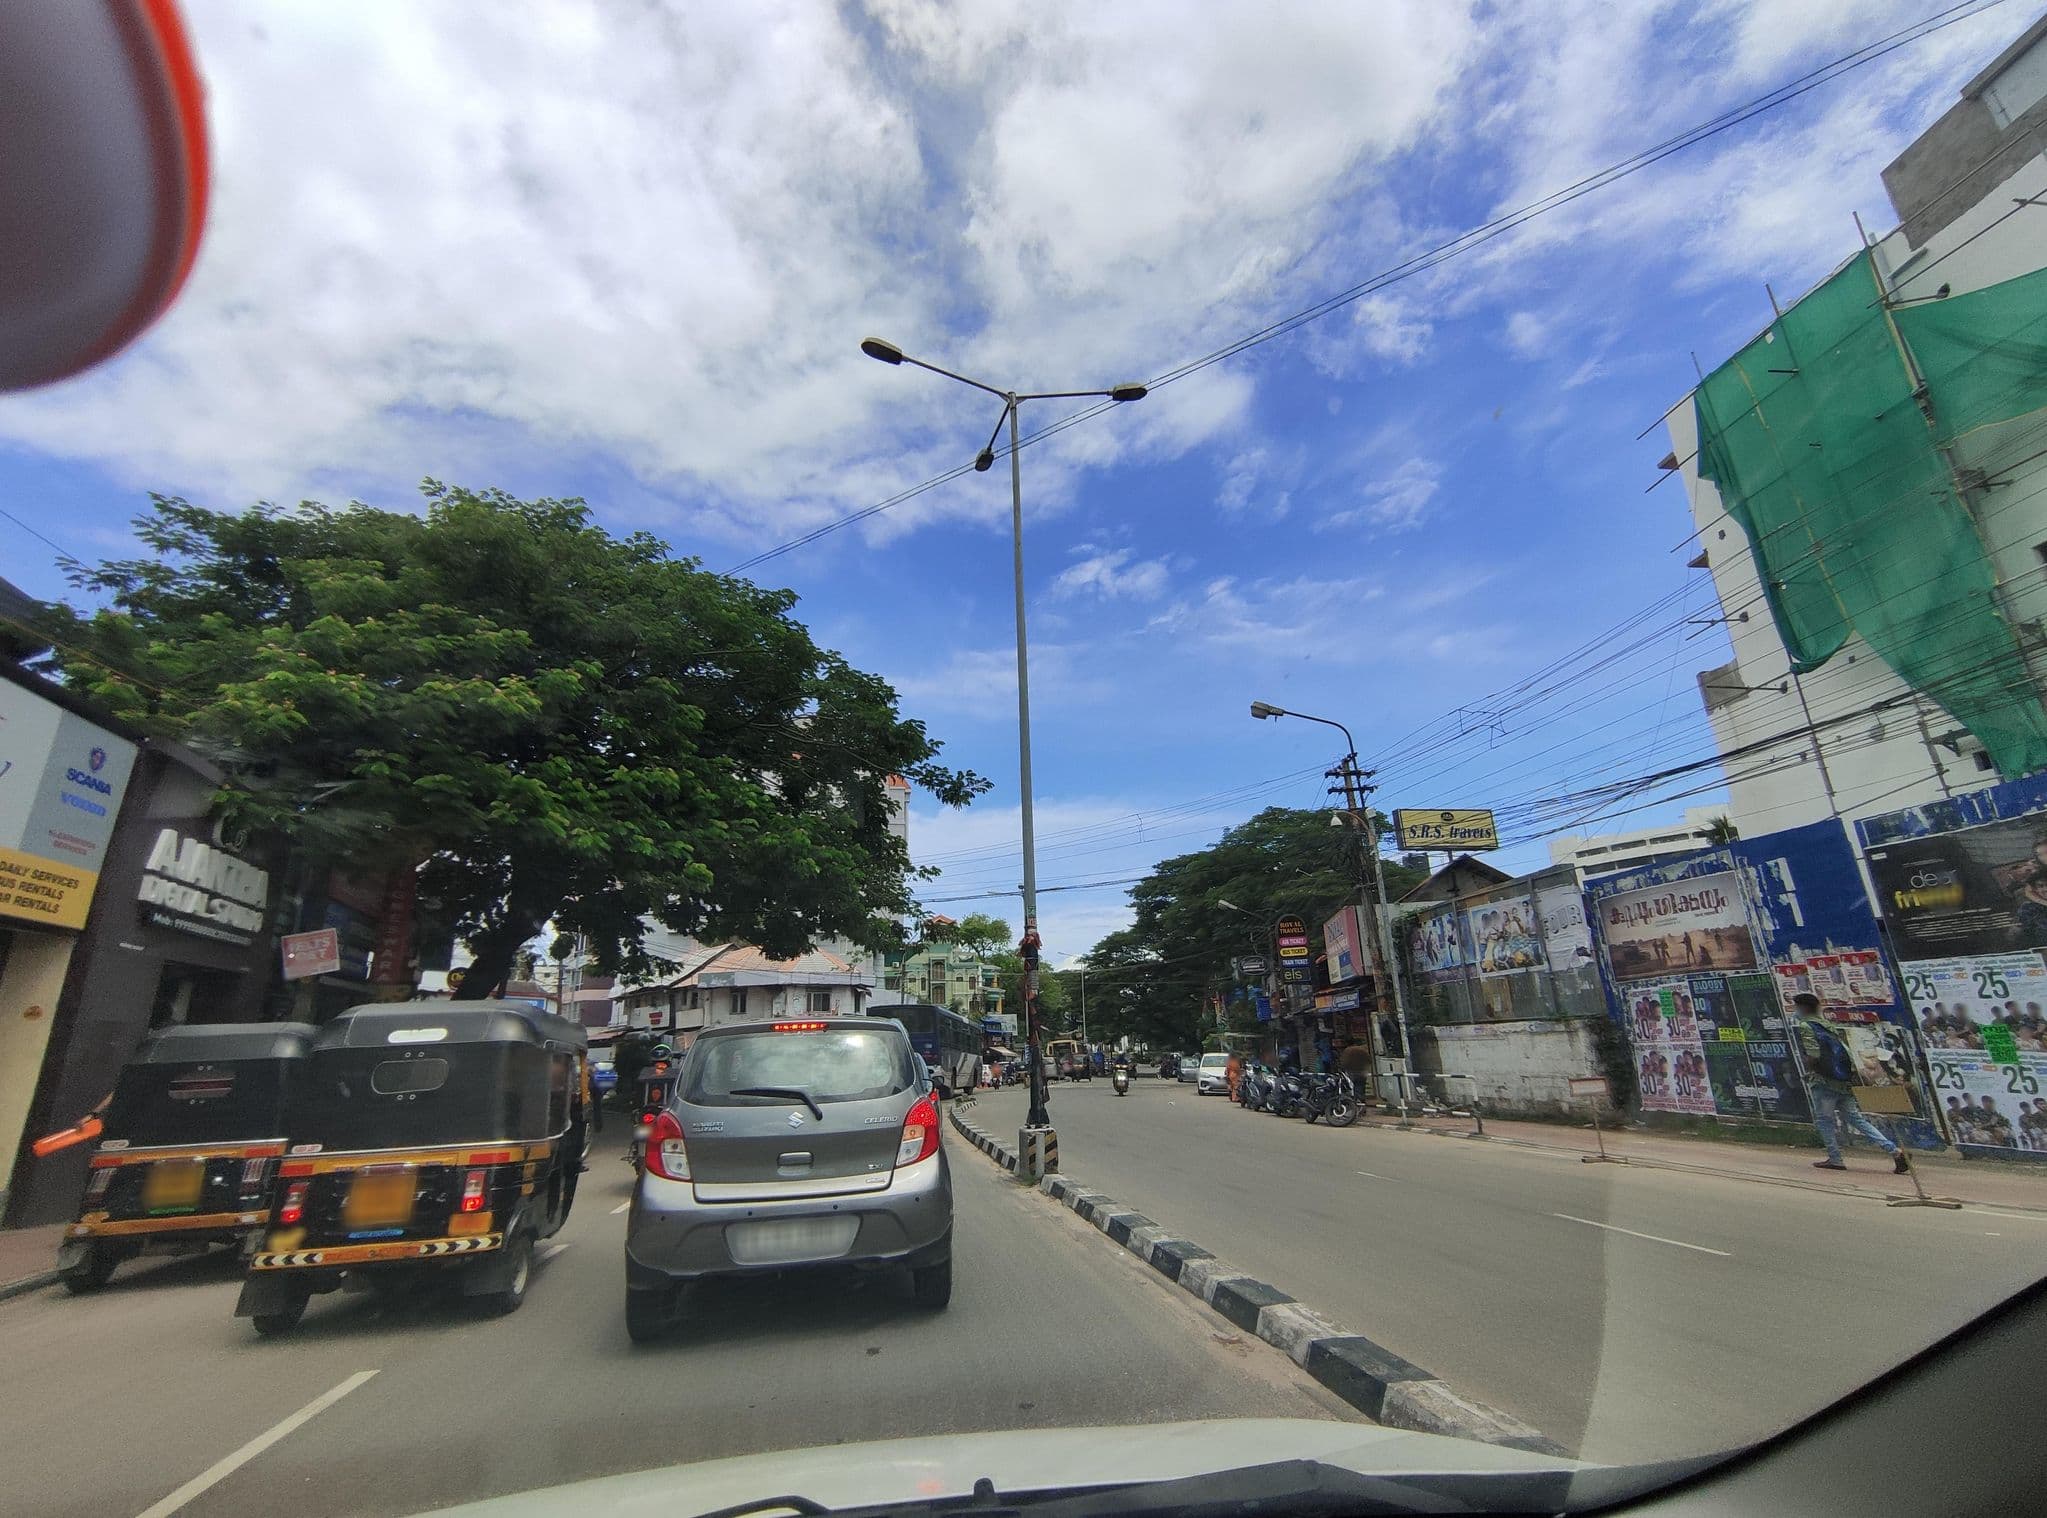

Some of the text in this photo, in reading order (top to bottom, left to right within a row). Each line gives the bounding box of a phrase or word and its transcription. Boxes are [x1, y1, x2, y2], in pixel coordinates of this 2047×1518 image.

[65, 768, 111, 796] SCANIA
[1409, 824, 1492, 838] S.R.S. travels
[31, 869, 80, 889] SERVICES
[1911, 869, 1957, 888] der
[18, 880, 65, 900] RENTALS
[14, 895, 61, 914] RENTALS
[1693, 980, 1725, 990] BLOODY
[1905, 972, 1938, 1001] 25
[1972, 967, 2010, 999] 25
[1694, 997, 1707, 1012] 10
[1636, 1017, 1650, 1039] 30
[1667, 1016, 1681, 1037] 30
[1749, 1043, 1787, 1054] BLOODY
[1752, 1061, 1767, 1077] 10
[1931, 1062, 1966, 1091] 25
[1640, 1073, 1657, 1096] 30
[1674, 1073, 1692, 1096] 30
[2002, 1065, 2039, 1095] 25
[864, 1115, 898, 1125] CELERIO
